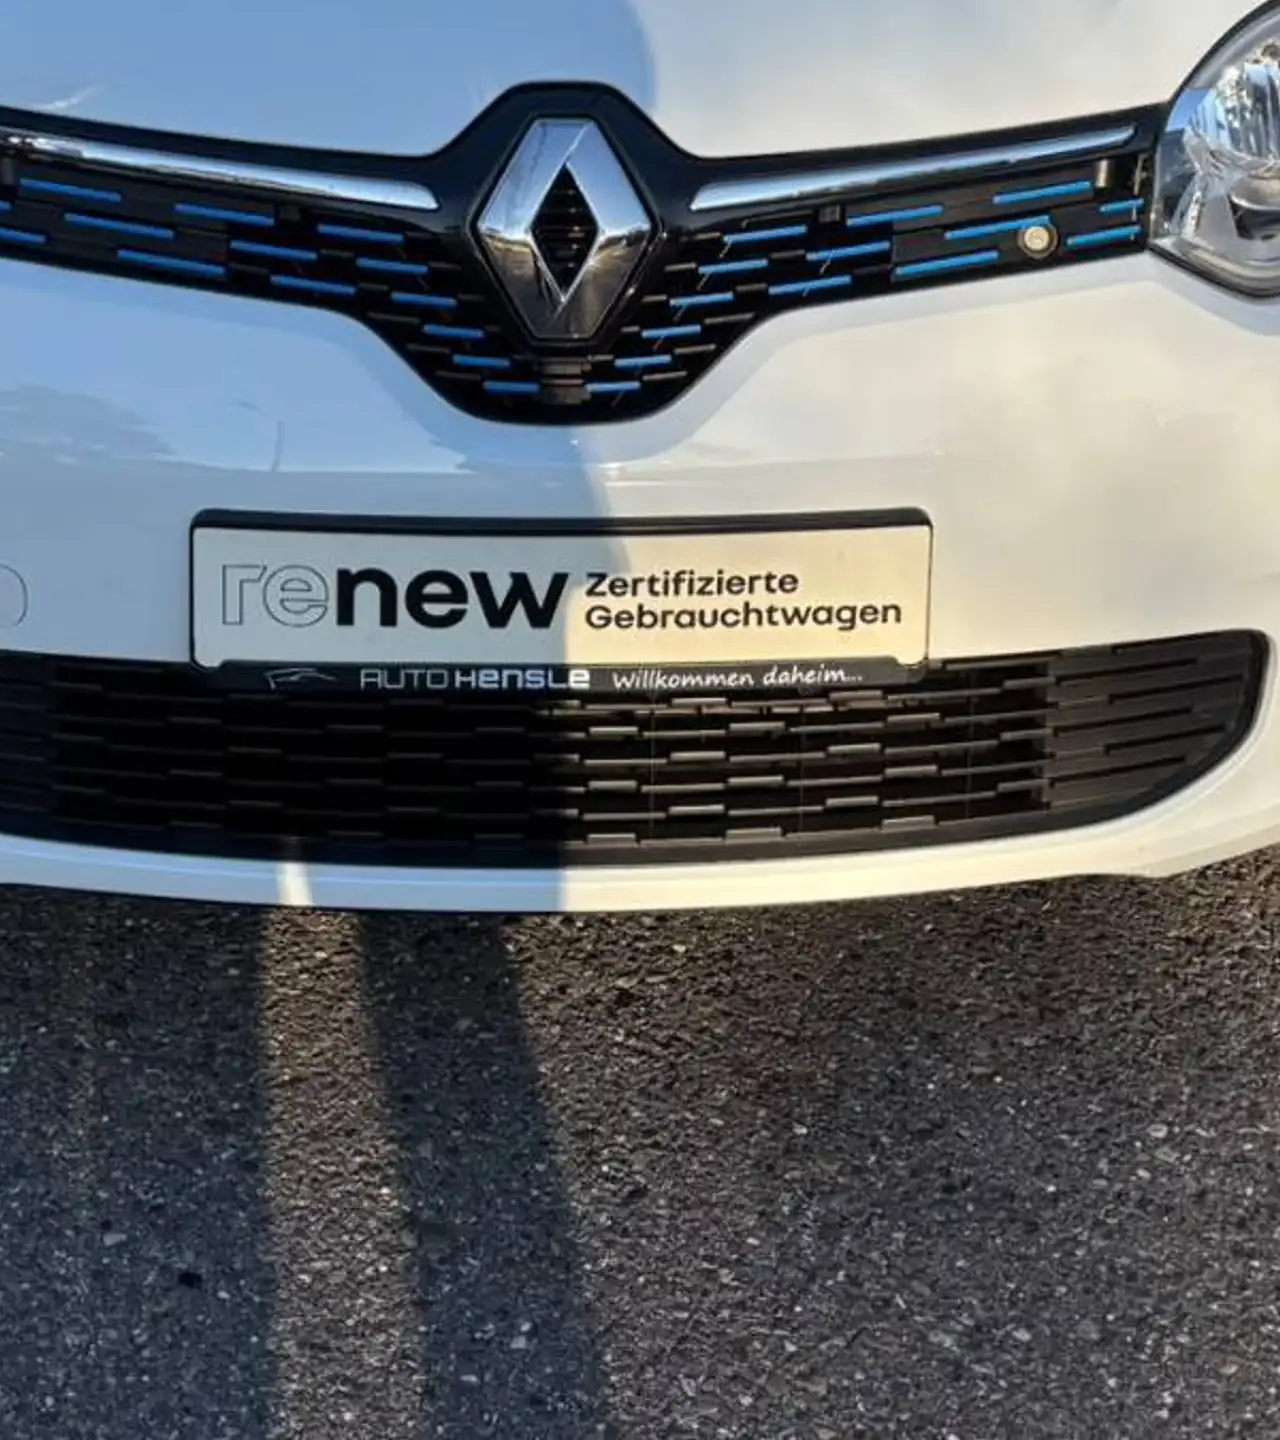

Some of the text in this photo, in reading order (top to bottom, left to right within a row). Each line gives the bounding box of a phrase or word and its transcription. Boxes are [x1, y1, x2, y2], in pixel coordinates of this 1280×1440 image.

[222, 564, 800, 629] renew Zertifizierte
[585, 601, 903, 631] Gebrauchtwagen
[611, 671, 755, 690] Willkommen
